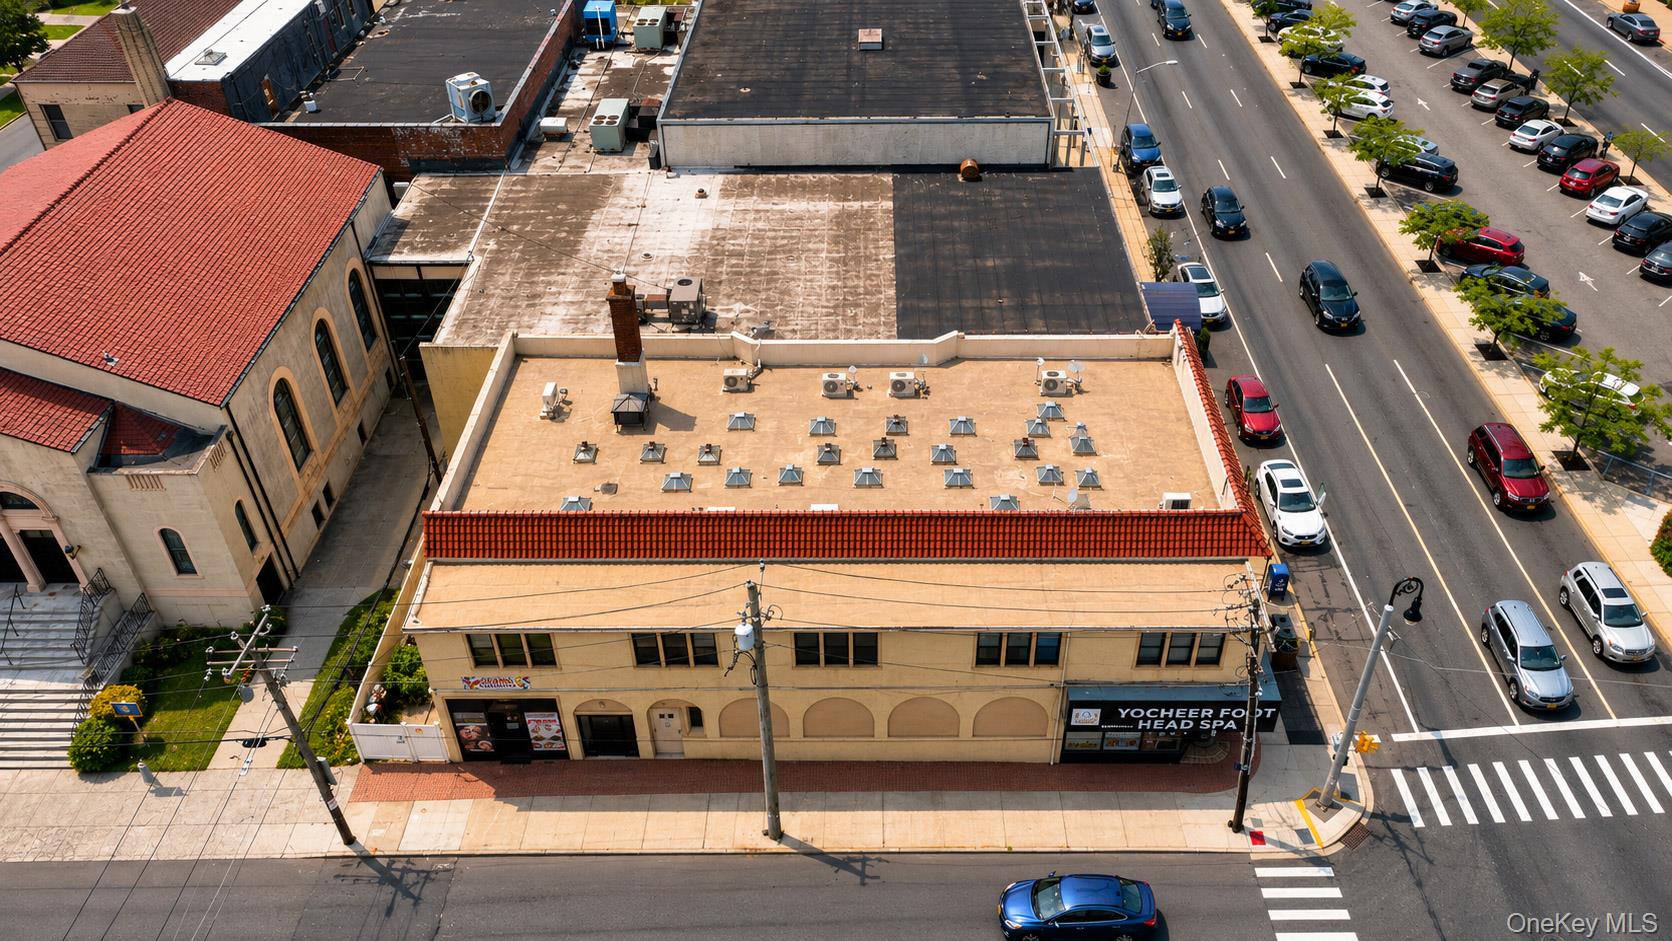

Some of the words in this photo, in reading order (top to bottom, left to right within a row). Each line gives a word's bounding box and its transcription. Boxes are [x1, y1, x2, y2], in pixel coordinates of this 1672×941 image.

[1118, 708, 1212, 718] YOCHEER
[1138, 719, 1194, 730] HEAD
[1199, 719, 1237, 730] SPA
